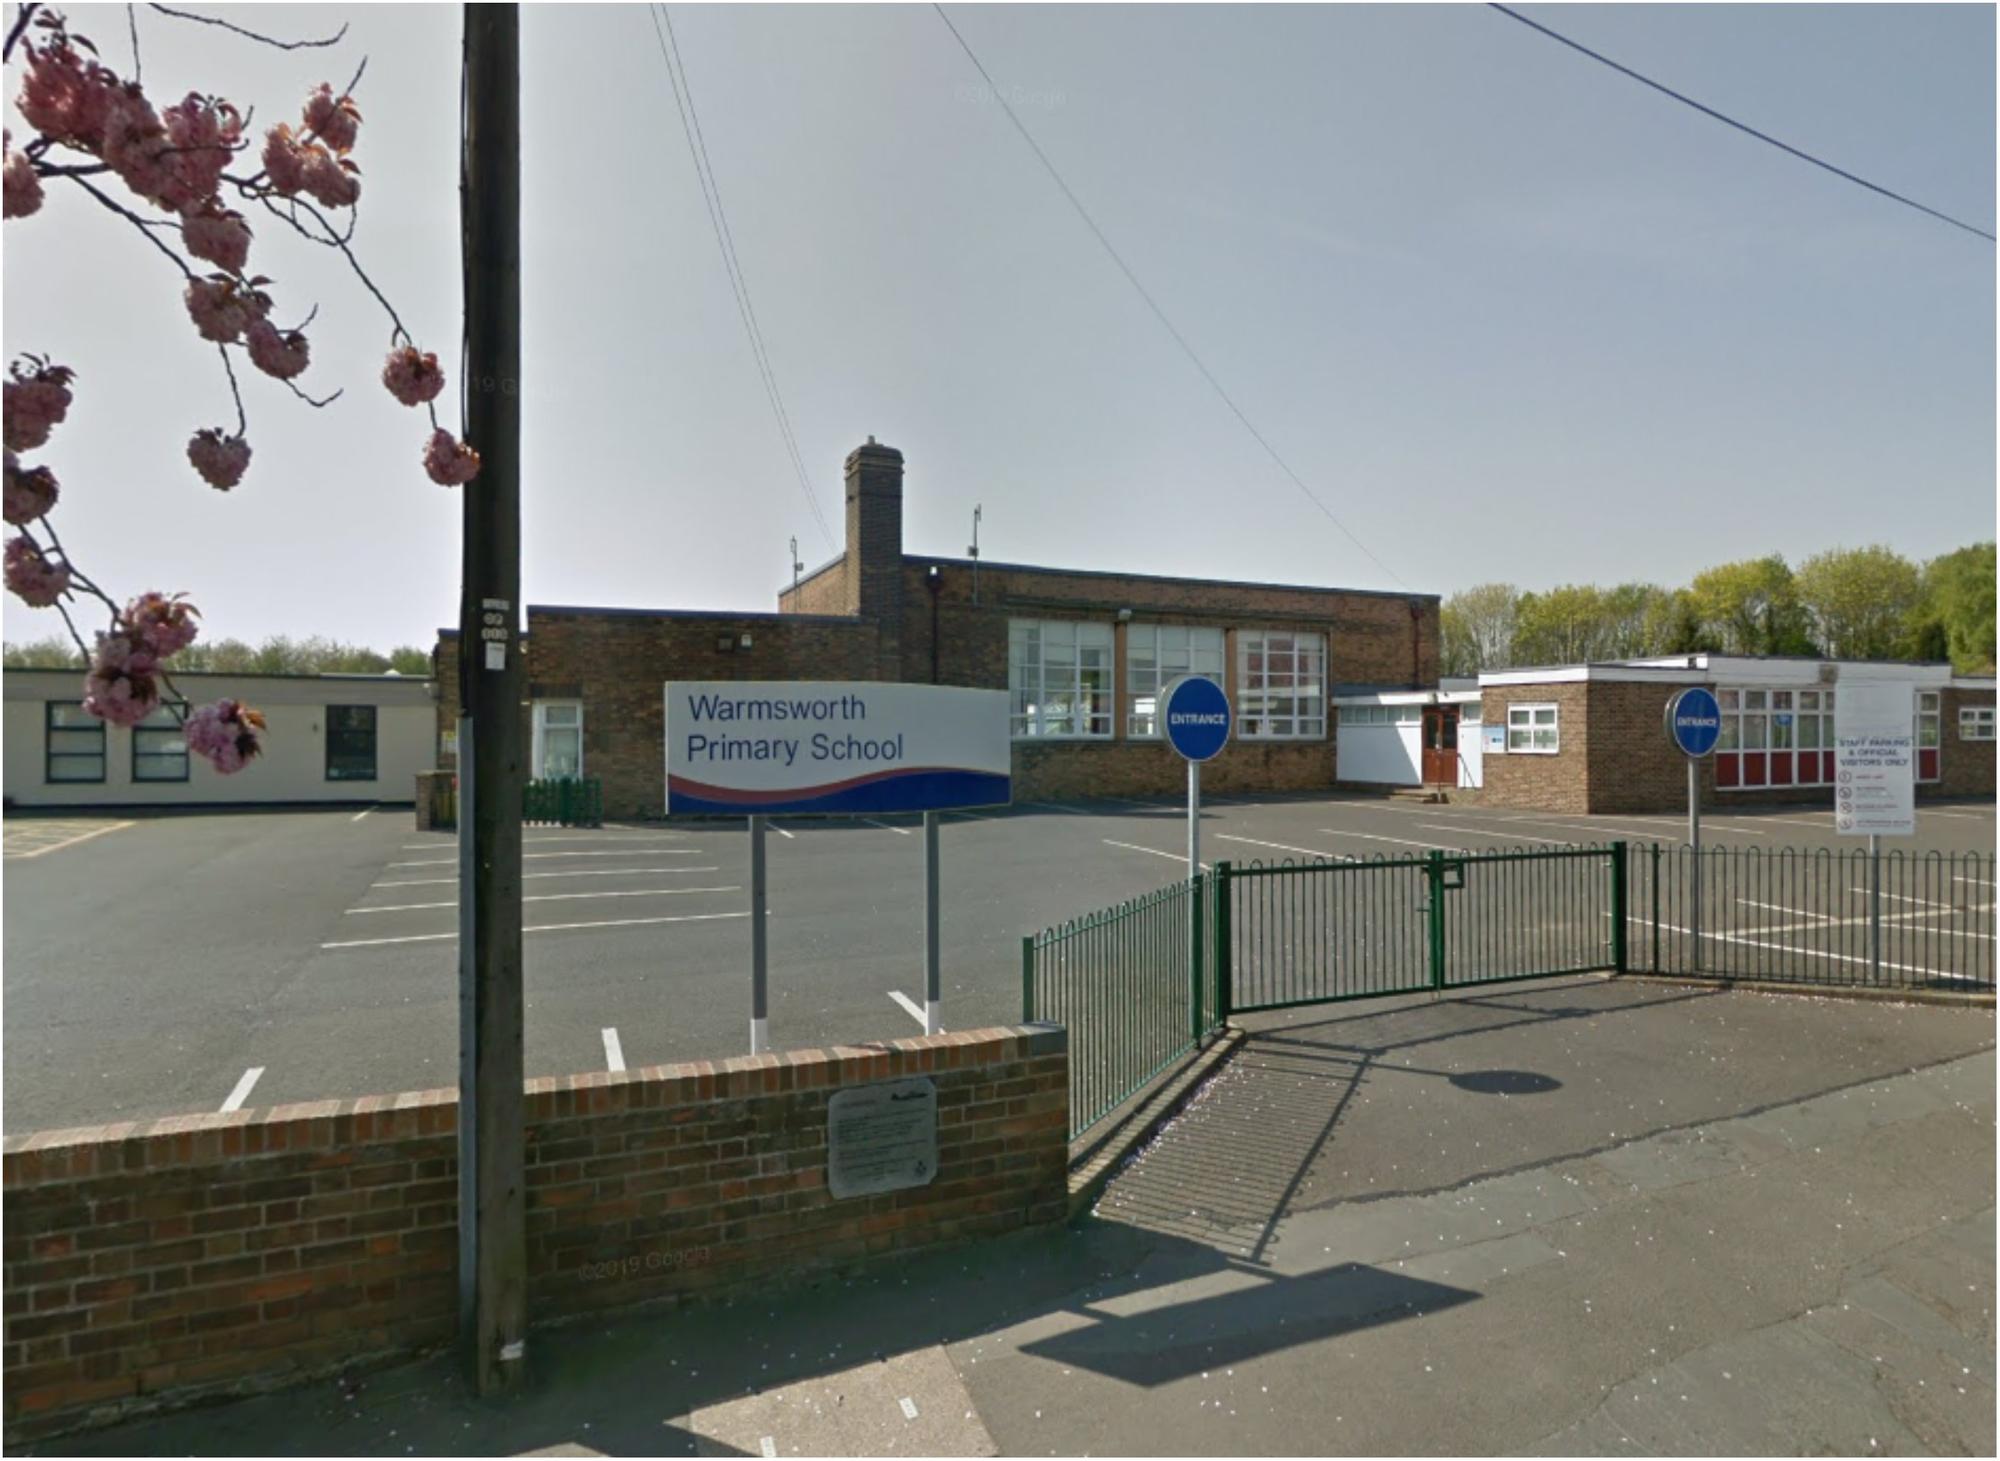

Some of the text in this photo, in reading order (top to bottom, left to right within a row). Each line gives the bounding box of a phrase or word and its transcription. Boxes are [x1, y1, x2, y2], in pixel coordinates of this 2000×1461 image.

[688, 695, 866, 721] Warmsworth
[1171, 713, 1225, 725] ENTRANCE
[1677, 717, 1716, 727] ENTRANCE
[687, 733, 903, 766] Primary School
[1869, 740, 1909, 748] PARKING
[1840, 758, 1908, 766] VISITORS ONLY
